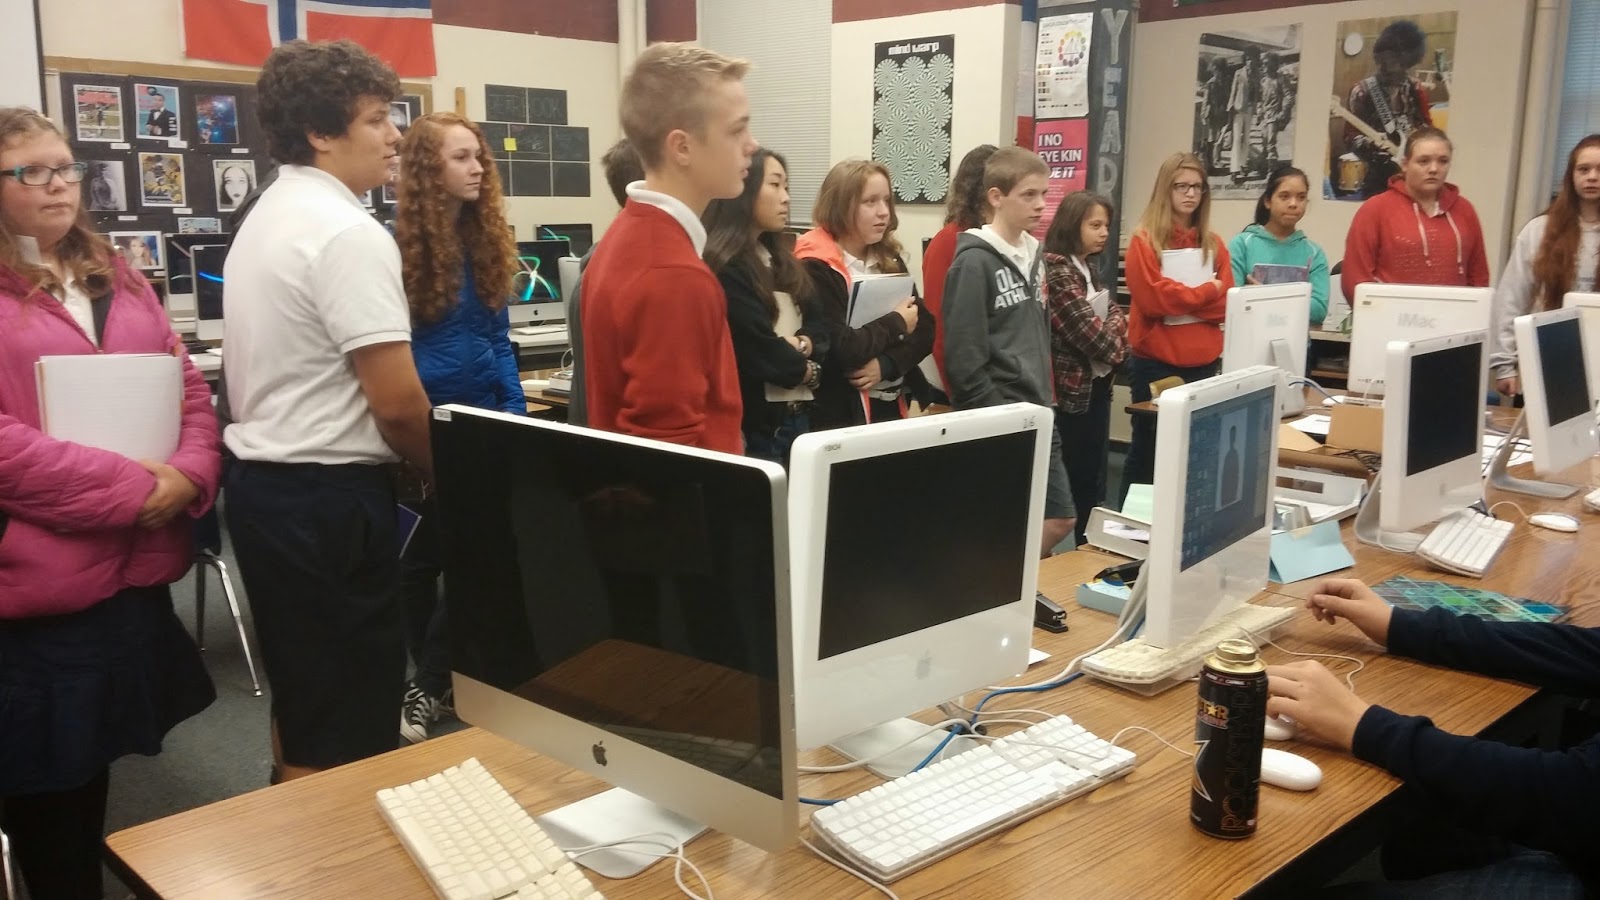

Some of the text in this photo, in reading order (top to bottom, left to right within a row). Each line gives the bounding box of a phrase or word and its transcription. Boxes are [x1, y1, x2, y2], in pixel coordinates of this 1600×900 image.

[888, 41, 940, 55] mind warp
[1044, 133, 1063, 147] NO
[1038, 149, 1082, 163] EYE KIN
[1062, 166, 1075, 178] IT
[1397, 312, 1439, 329] iMac
